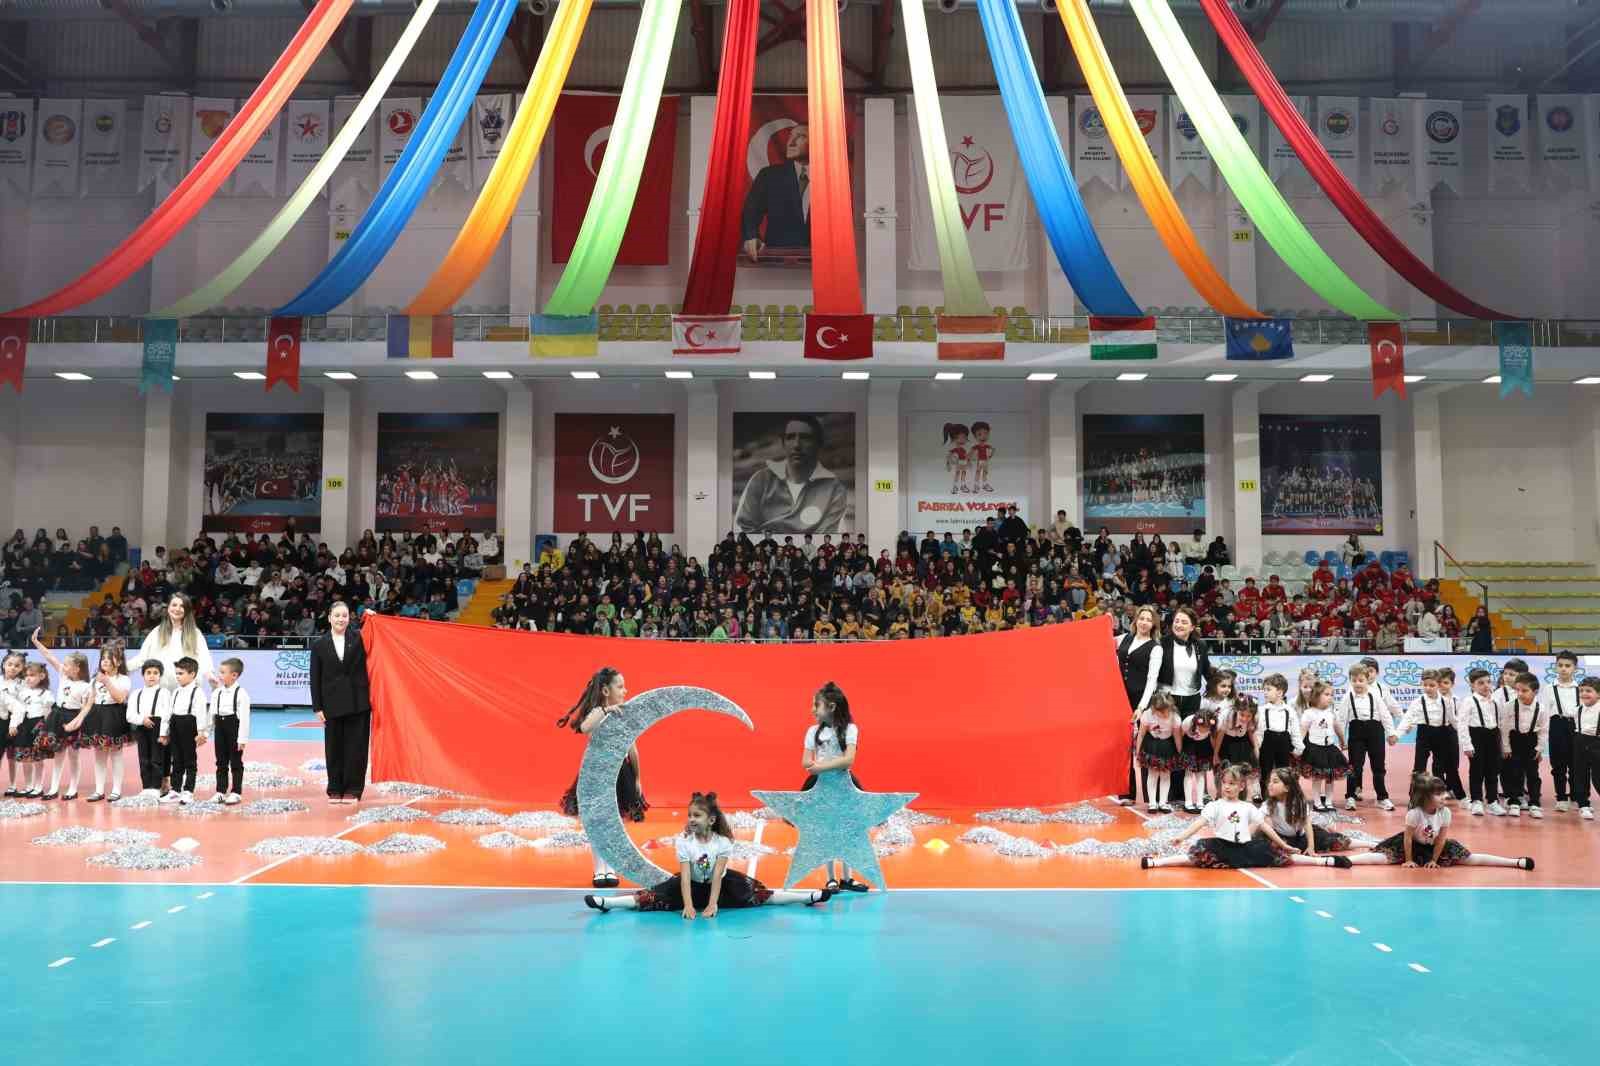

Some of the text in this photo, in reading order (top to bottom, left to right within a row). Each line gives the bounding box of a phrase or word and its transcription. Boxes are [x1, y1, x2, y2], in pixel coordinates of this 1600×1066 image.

[959, 203, 1005, 232] VF
[577, 493, 651, 522] TVF
[276, 671, 310, 679] NİLÜFE
[1390, 686, 1424, 695] NİLÜFE
